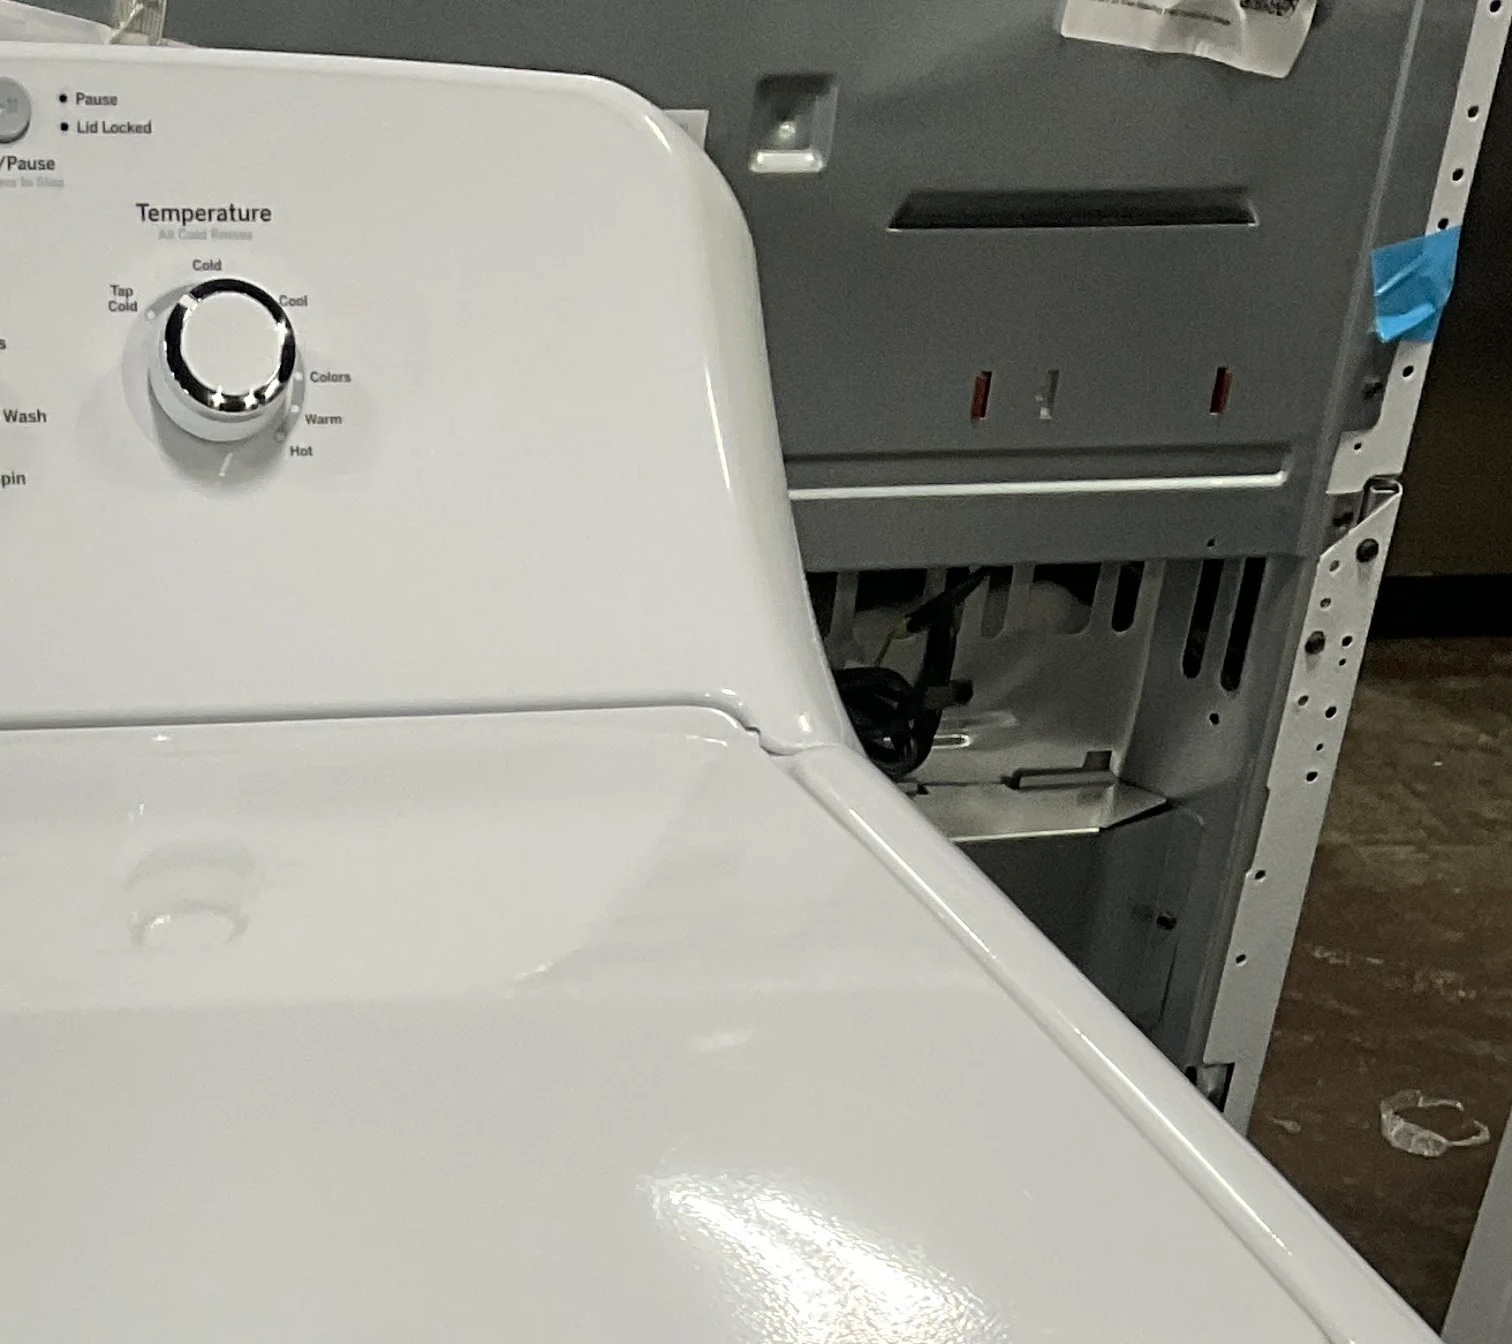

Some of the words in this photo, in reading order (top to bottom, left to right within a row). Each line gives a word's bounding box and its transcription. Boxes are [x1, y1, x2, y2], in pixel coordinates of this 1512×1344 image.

[75, 91, 118, 106] Pause
[76, 120, 99, 134] Lid
[101, 120, 152, 135] Locked
[135, 202, 272, 226] Temperature
[191, 258, 222, 272] Cold
[110, 285, 134, 299] Tap
[107, 299, 138, 313] Cold
[278, 294, 309, 307] Cool
[309, 370, 352, 384] Colors
[2, 408, 47, 424] Wash
[304, 413, 343, 425] Warm
[289, 445, 313, 457] Hot
